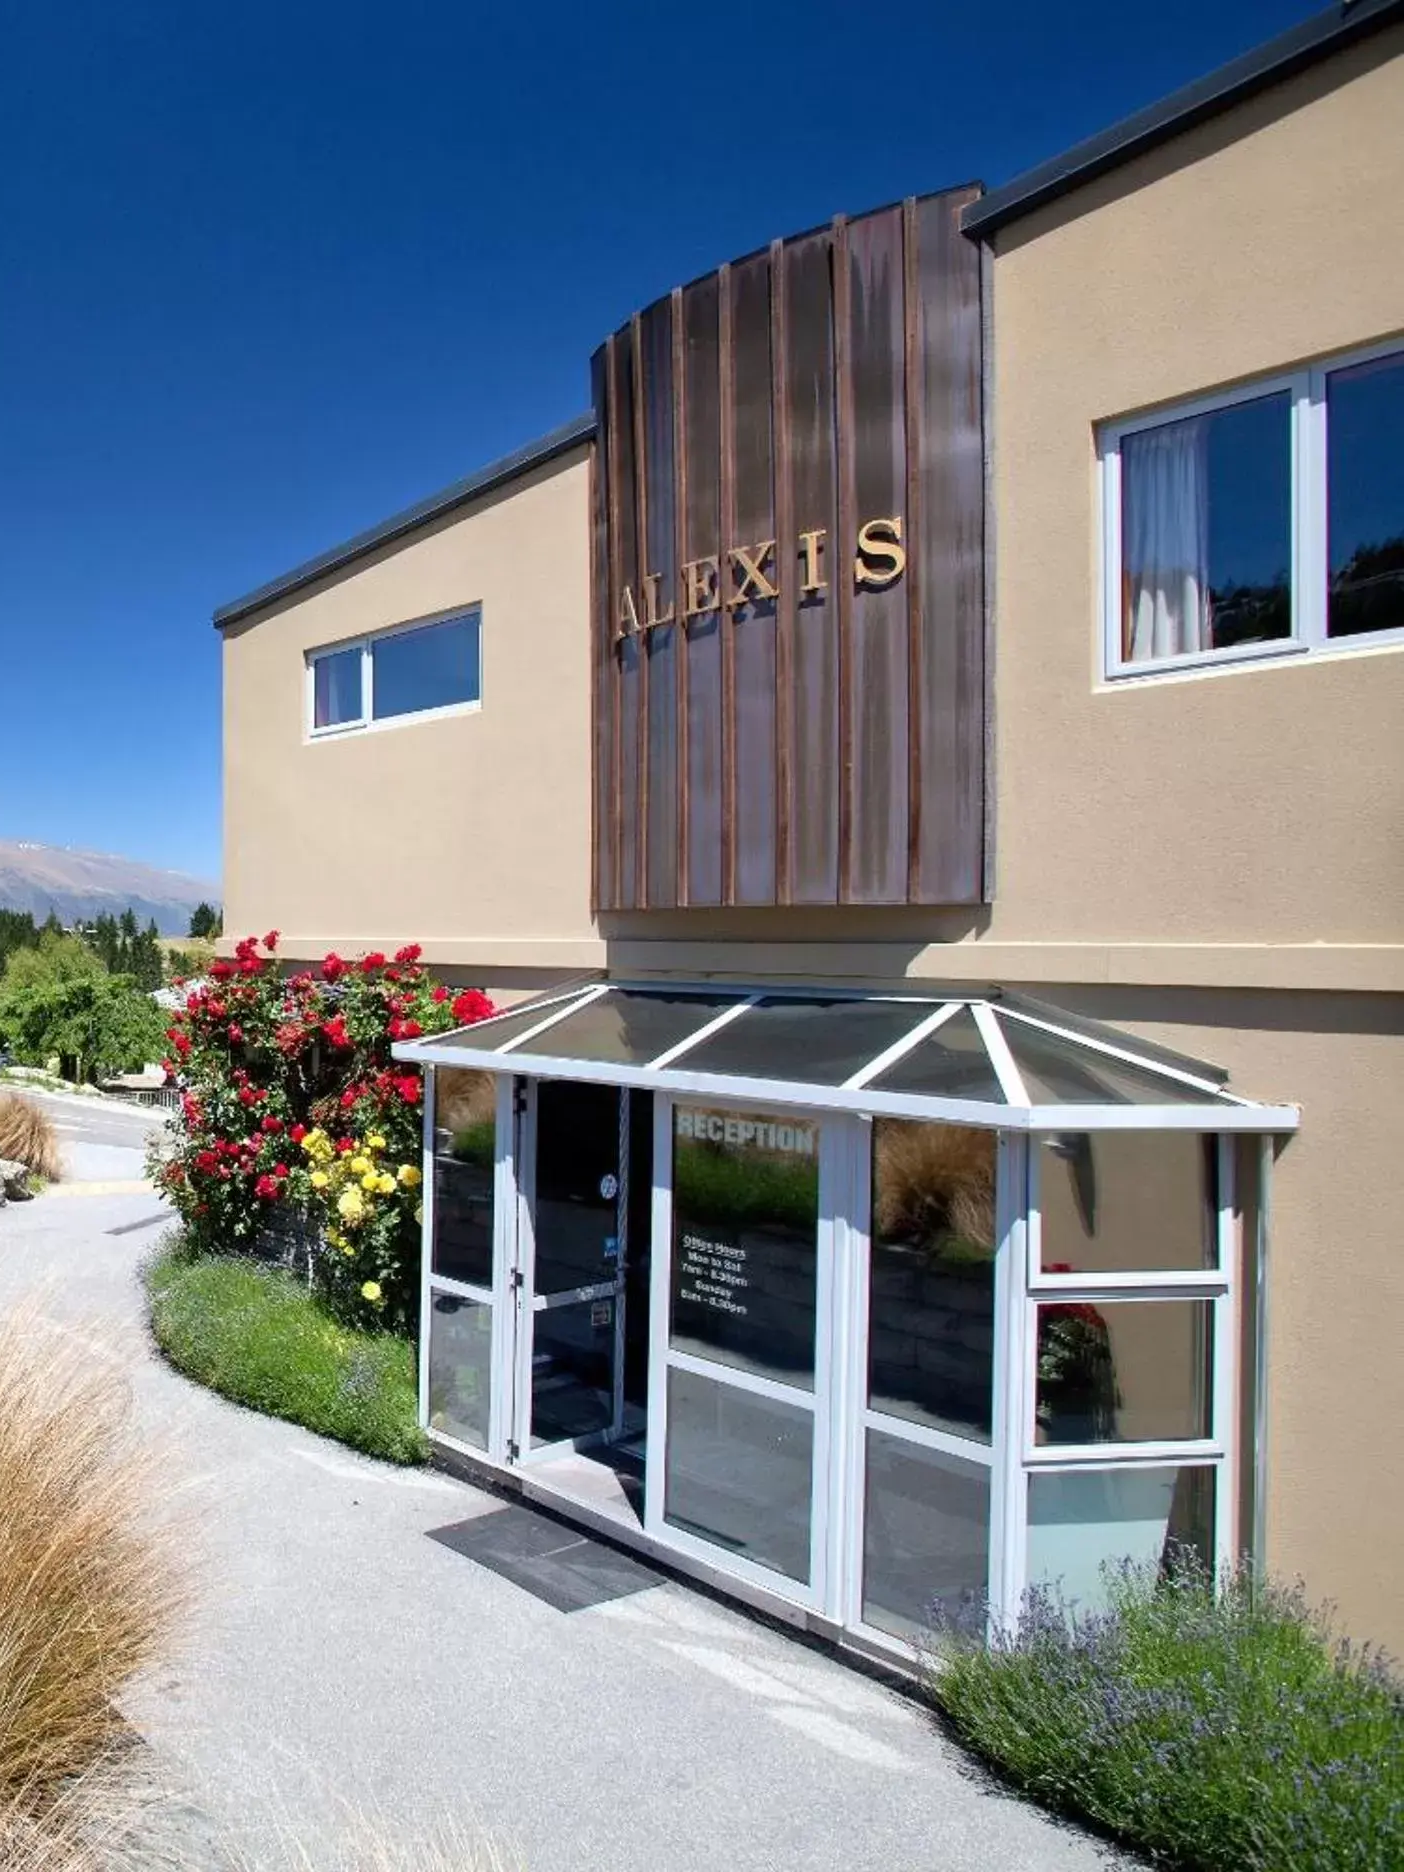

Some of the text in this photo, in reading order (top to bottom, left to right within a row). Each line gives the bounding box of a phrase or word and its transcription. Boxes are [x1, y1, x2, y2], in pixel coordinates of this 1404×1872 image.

[615, 516, 906, 638] ALEXIS
[676, 1113, 814, 1155] RECEPTION
[723, 1259, 742, 1272] Sat
[694, 1279, 733, 1300] Sunday
